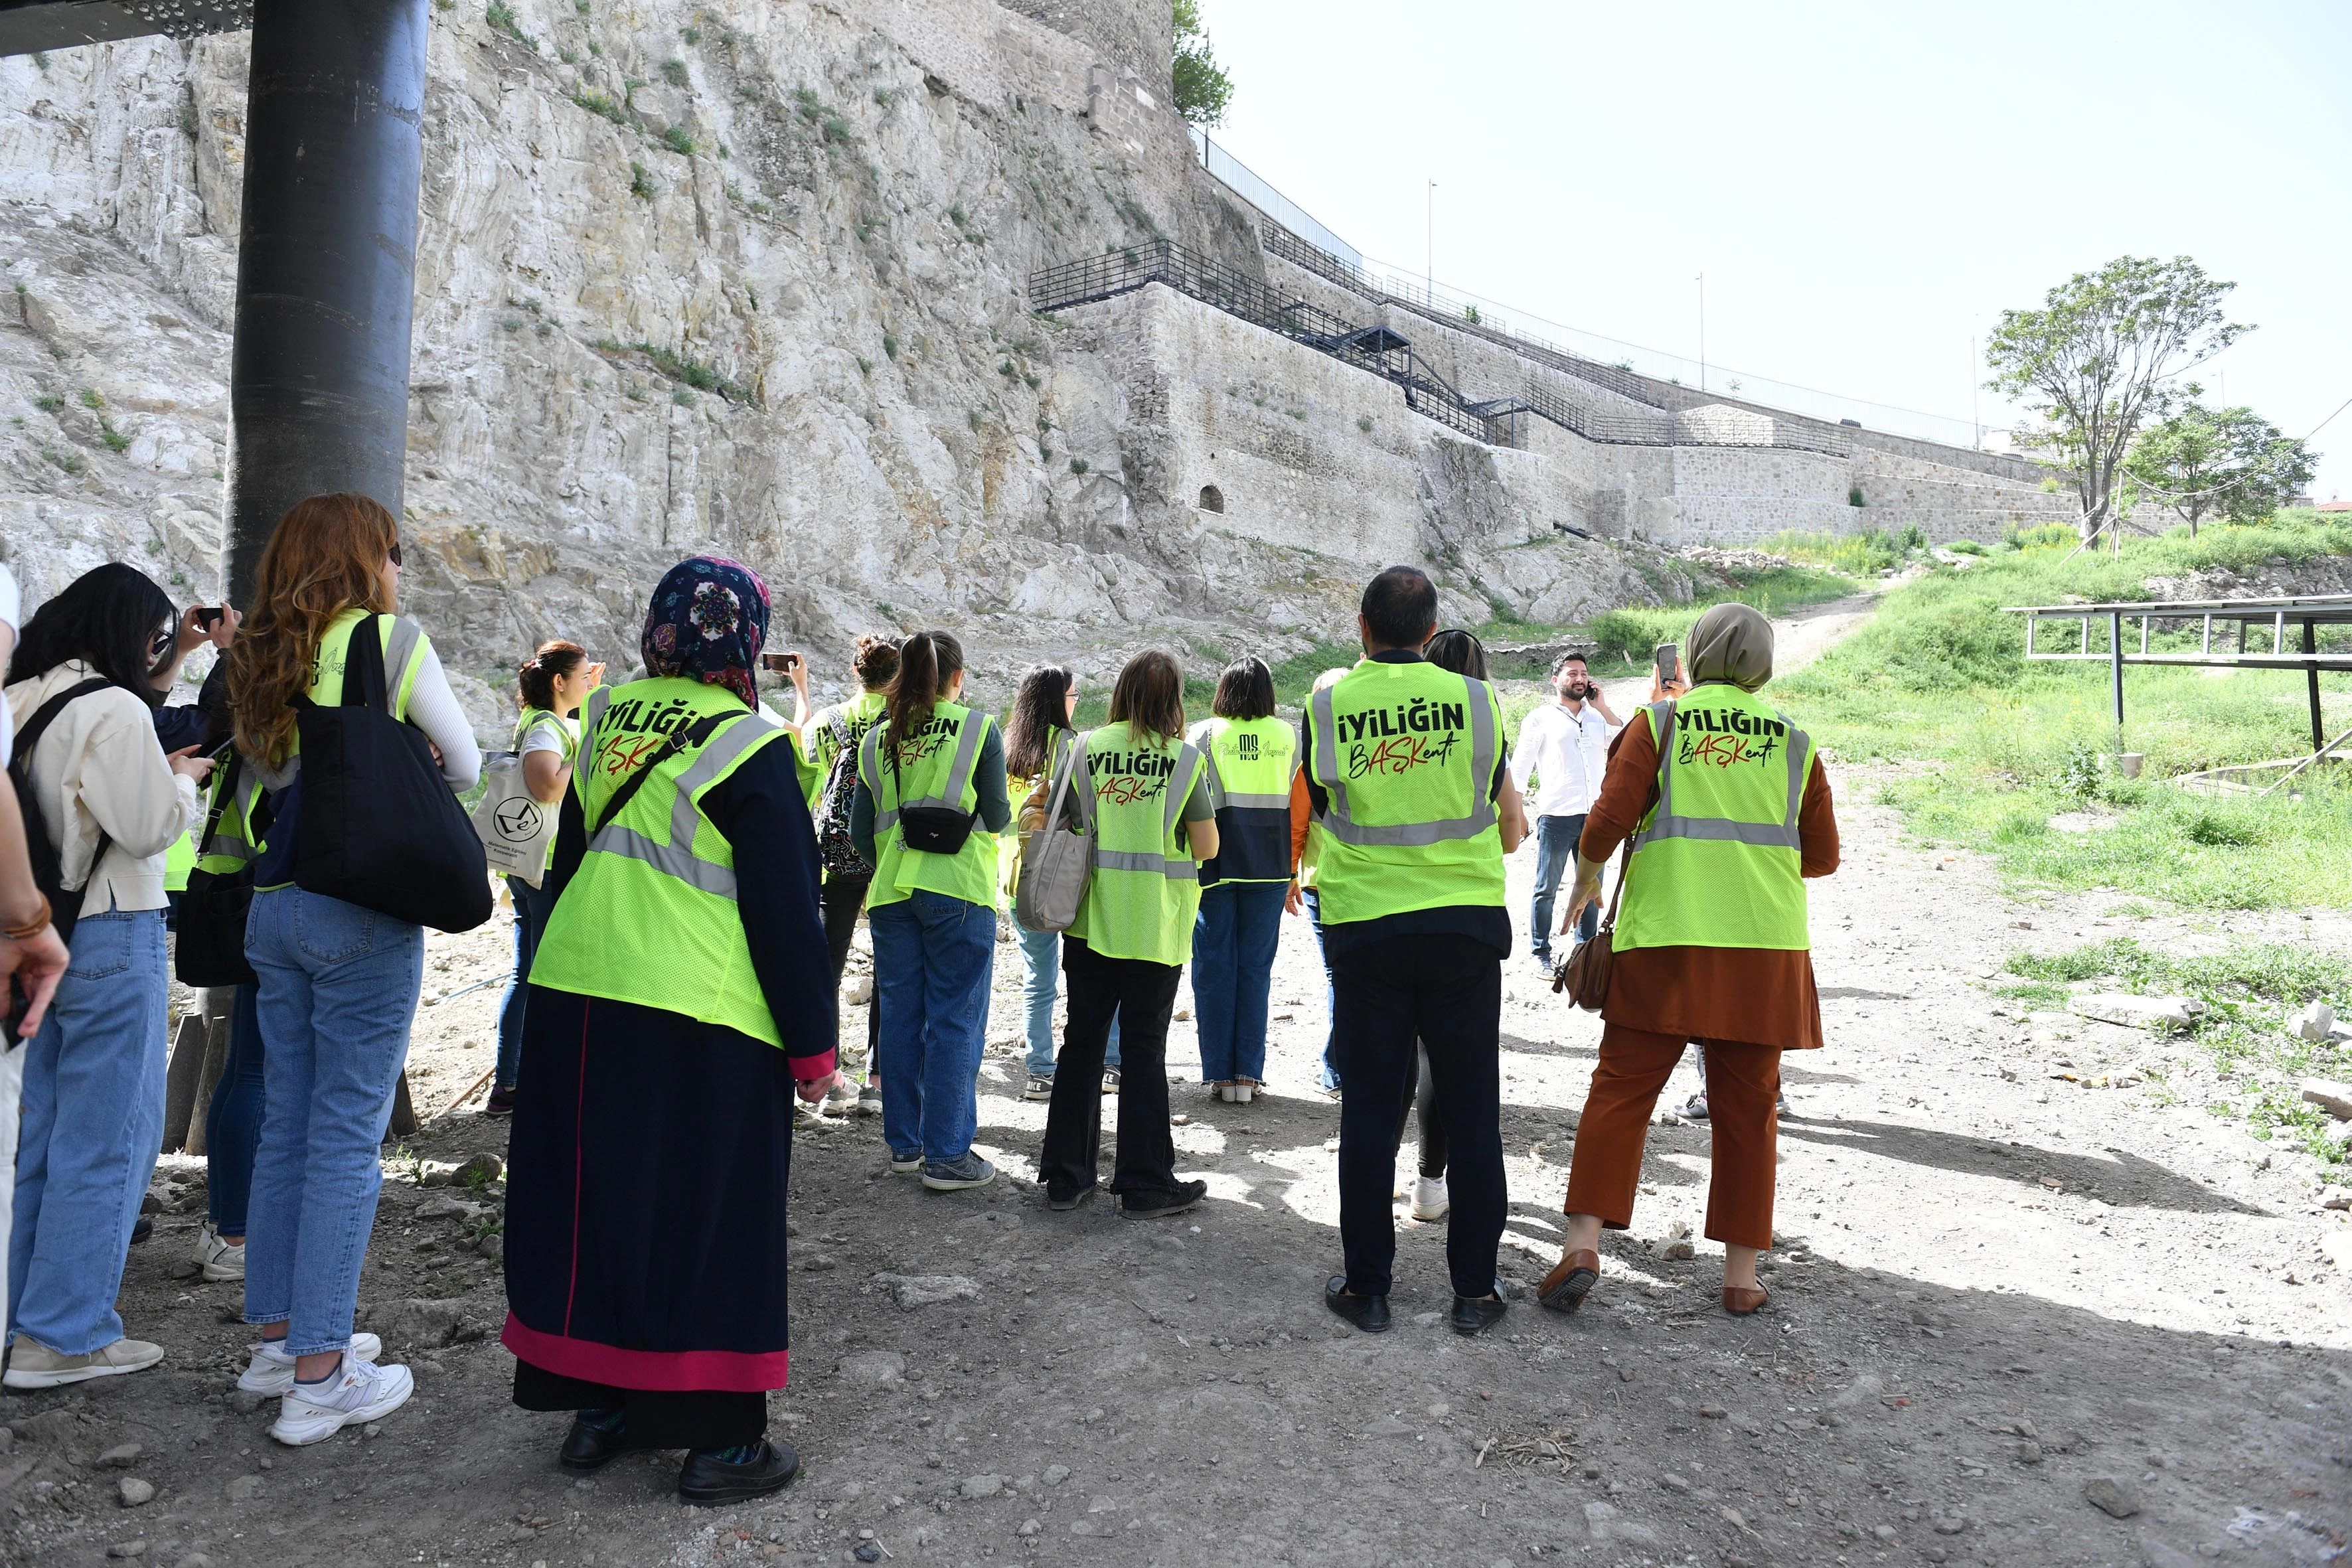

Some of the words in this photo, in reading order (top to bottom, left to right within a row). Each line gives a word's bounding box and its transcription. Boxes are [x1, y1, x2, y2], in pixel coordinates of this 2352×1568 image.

[1338, 698, 1464, 743] İYİLİĞİN
[1675, 708, 1784, 737] YİLİĞİN
[1087, 748, 1176, 781] İYİLİĞİN
[1349, 731, 1461, 779] BAŞKenti
[1095, 776, 1168, 806] AŞKenti
[1026, 1081, 1042, 1091] IKE
